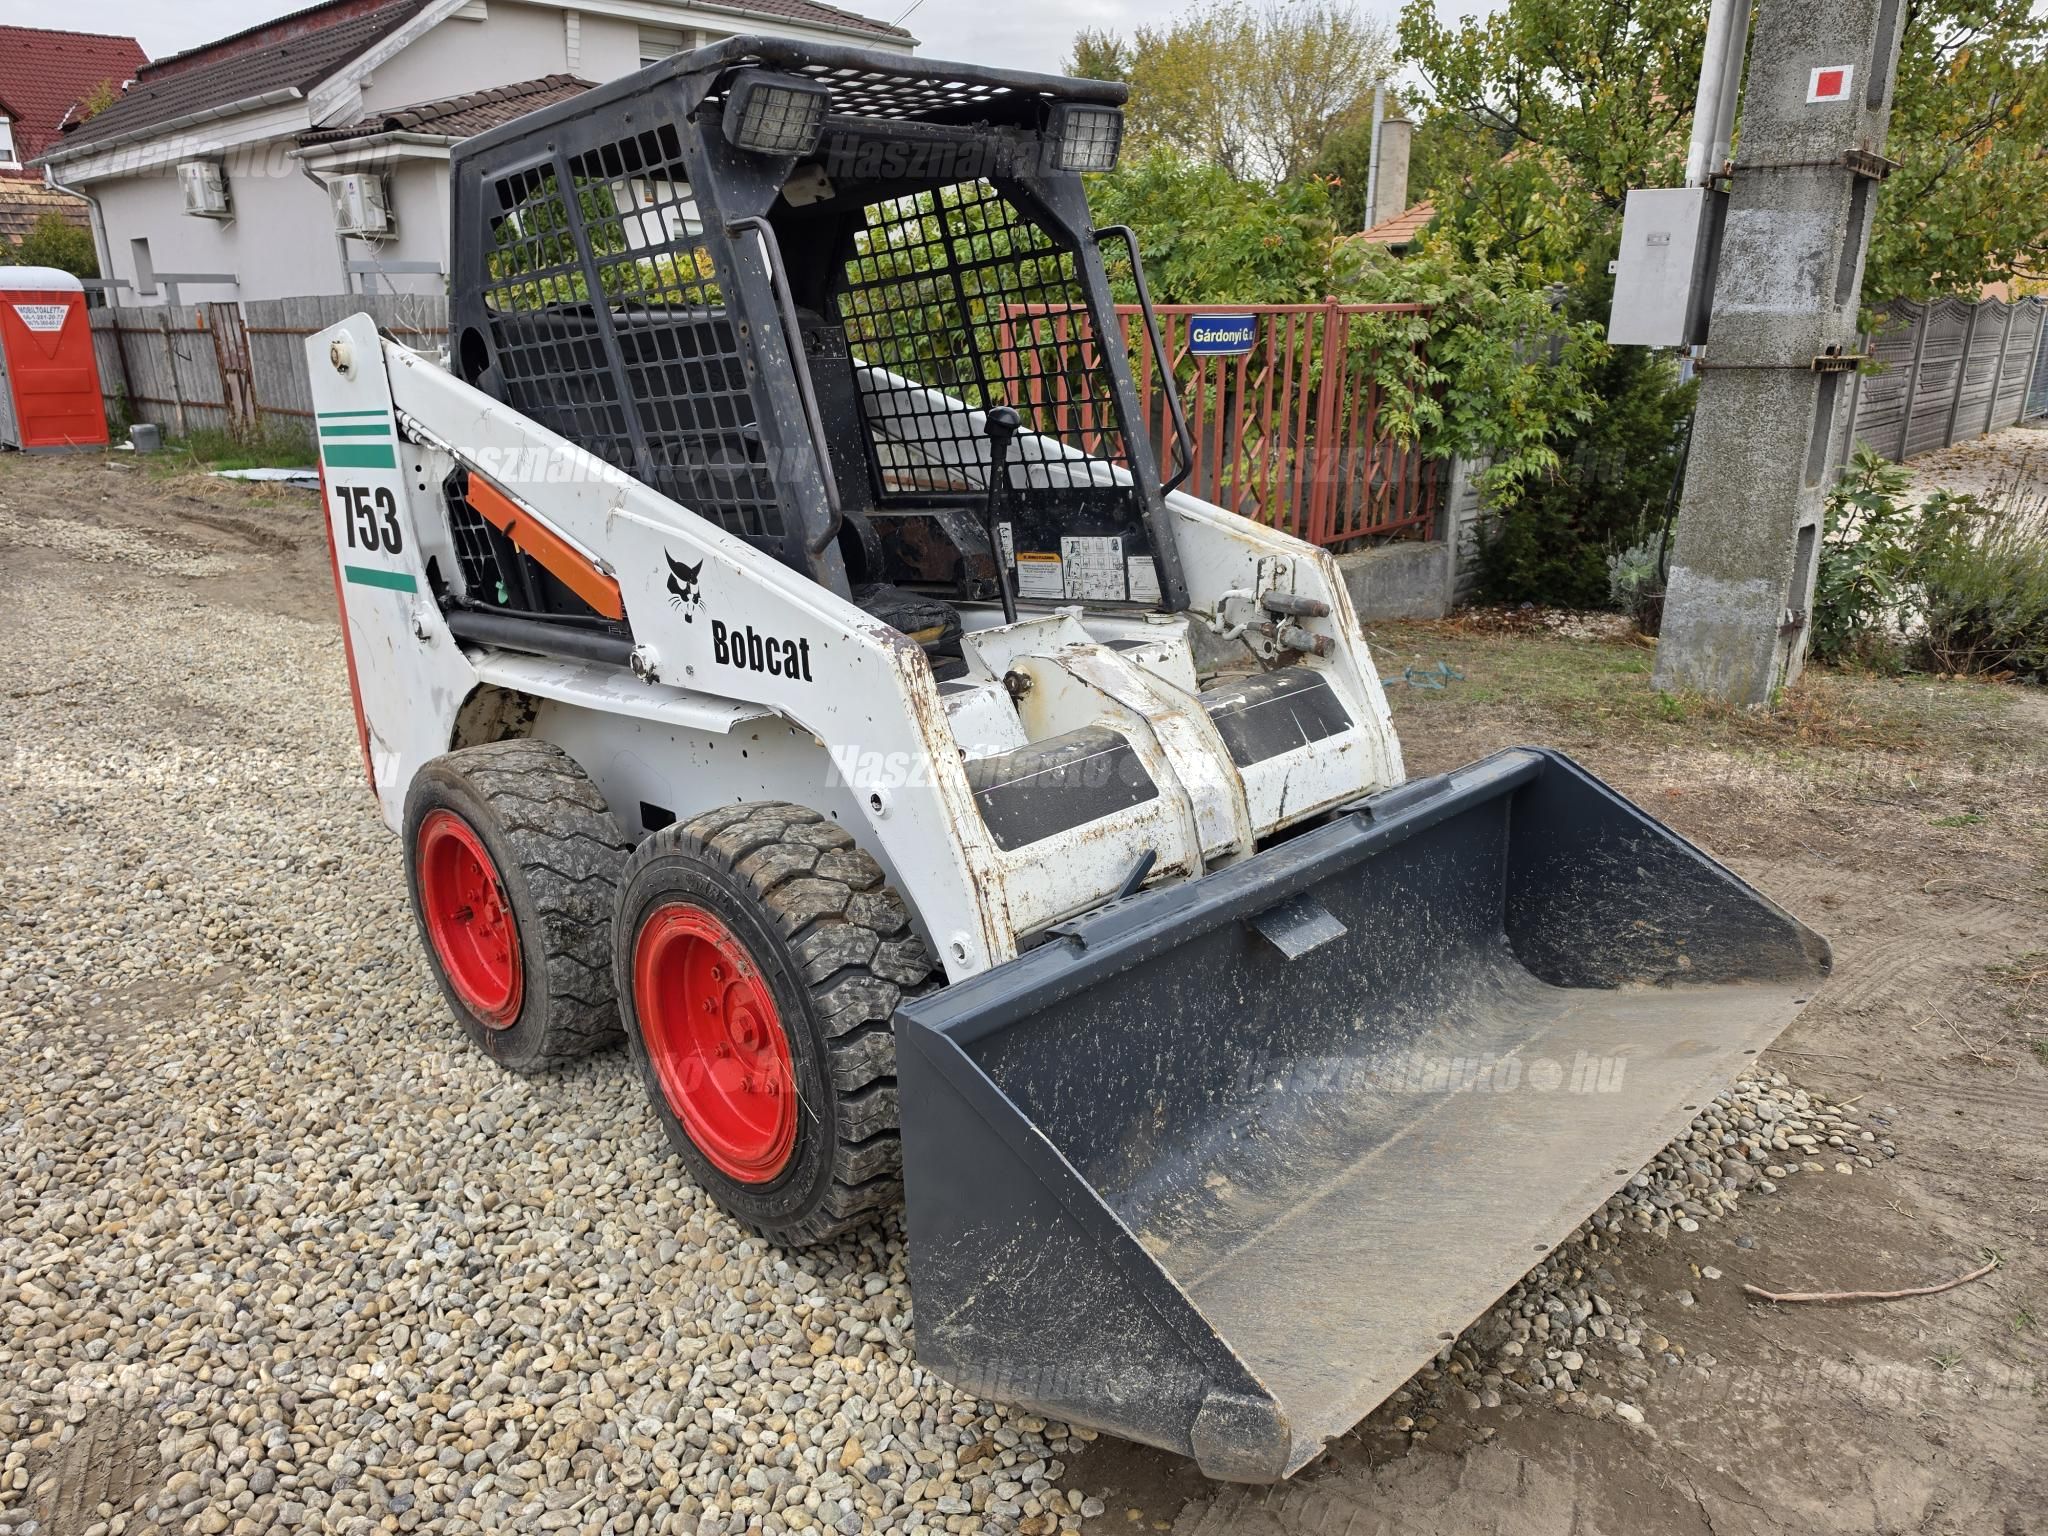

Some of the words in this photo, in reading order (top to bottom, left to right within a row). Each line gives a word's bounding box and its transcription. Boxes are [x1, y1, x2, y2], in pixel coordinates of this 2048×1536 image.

[1193, 327, 1242, 345] Gárdonyi
[335, 485, 403, 555] 753
[711, 619, 813, 682] Bobcat
